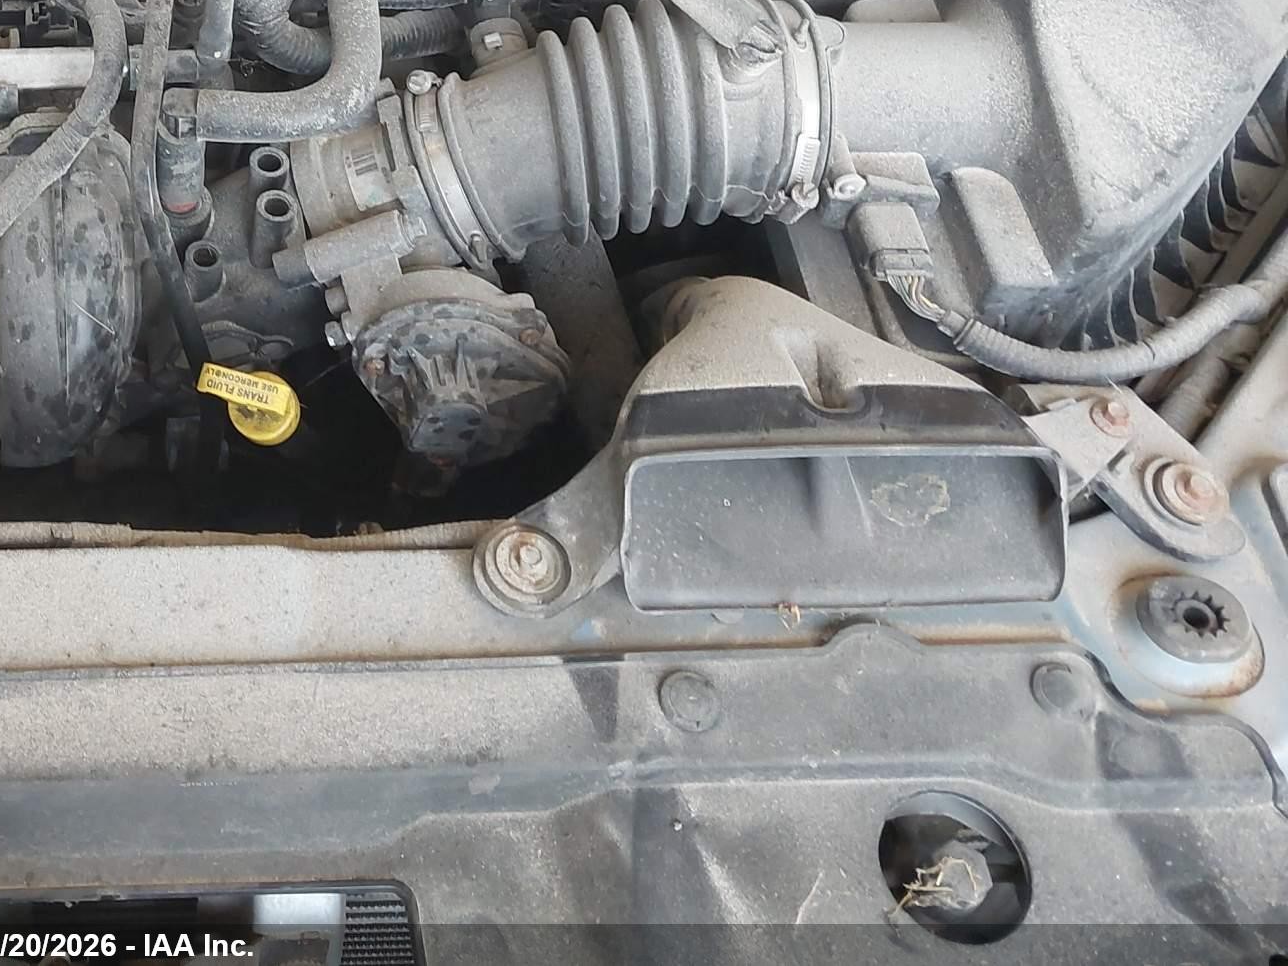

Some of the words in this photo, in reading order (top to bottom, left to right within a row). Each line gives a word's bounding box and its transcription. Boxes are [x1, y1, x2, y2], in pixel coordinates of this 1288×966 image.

[207, 379, 235, 394] FLUID
[261, 383, 279, 395] USE
[237, 388, 269, 404] TRANS
